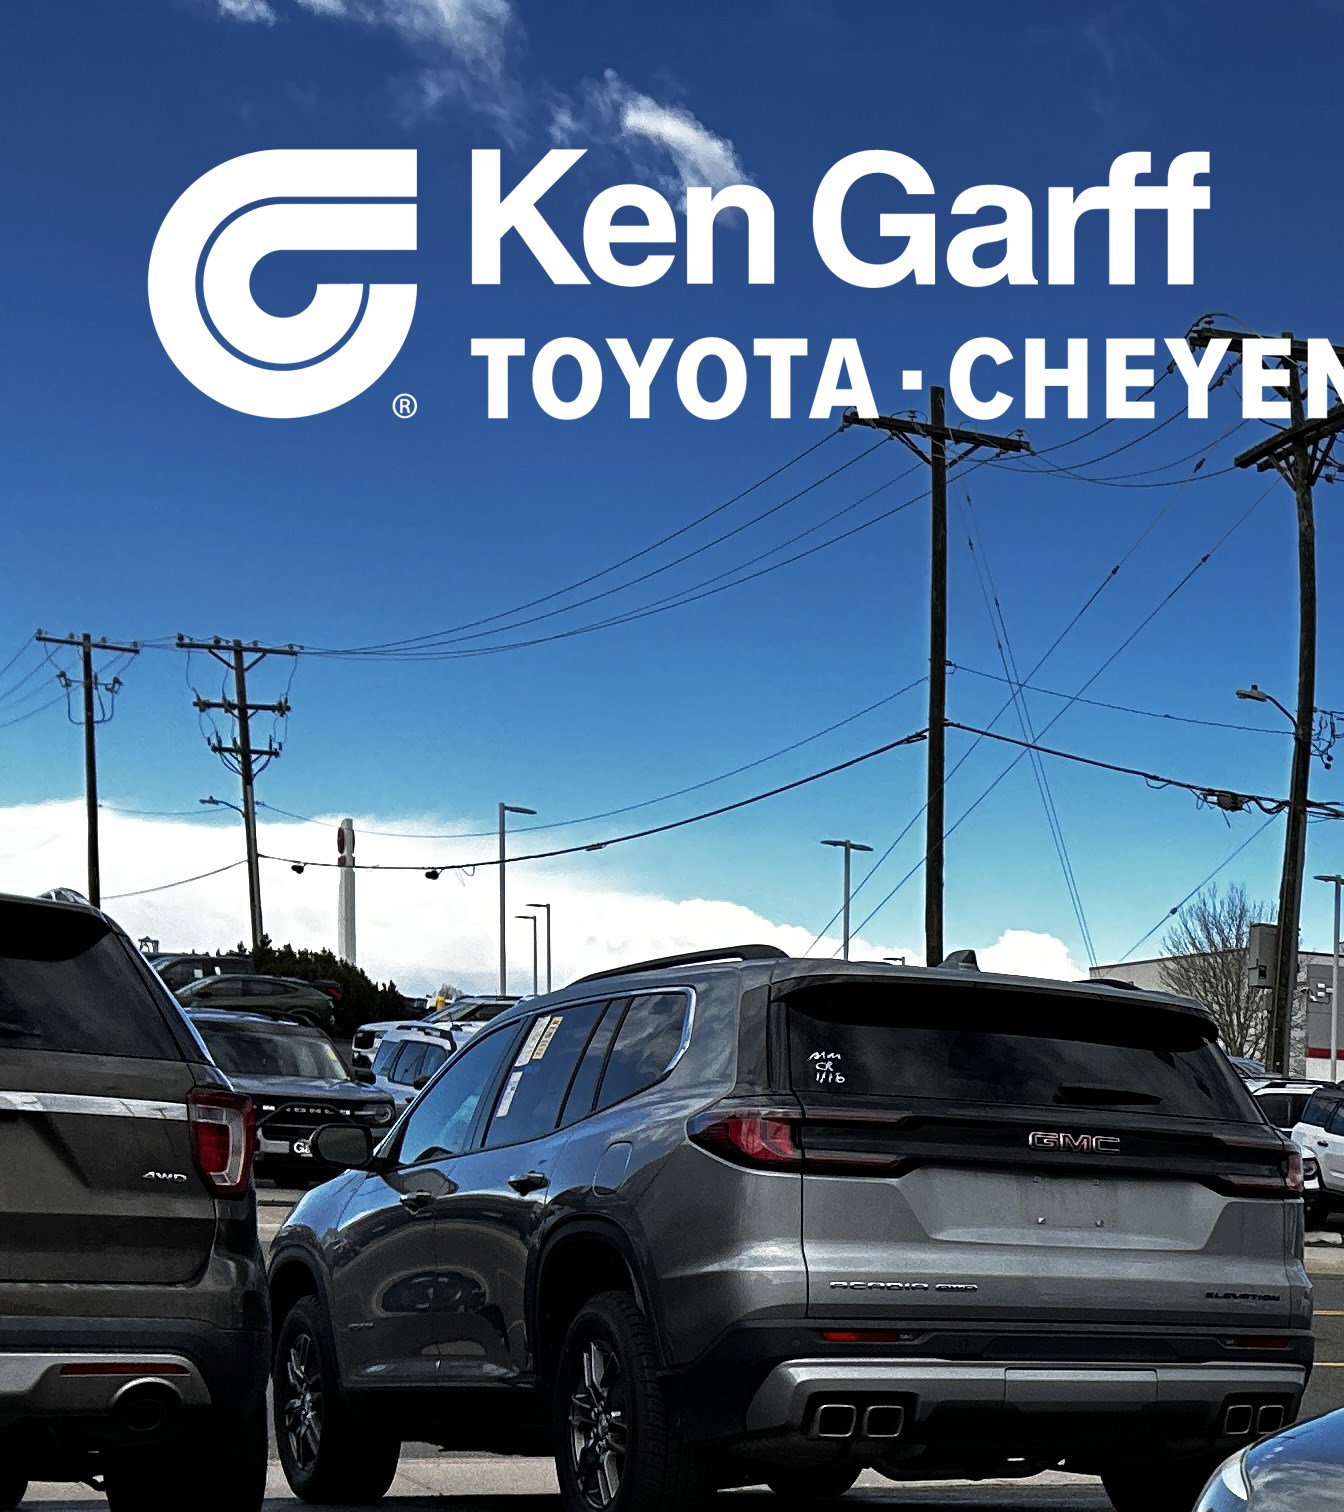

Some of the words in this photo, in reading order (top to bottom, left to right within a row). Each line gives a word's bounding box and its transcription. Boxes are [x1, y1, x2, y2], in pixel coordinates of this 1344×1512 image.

[1028, 1131, 1121, 1154] GMC
[142, 1171, 187, 1182] AWD
[829, 1281, 930, 1291] ACADIA
